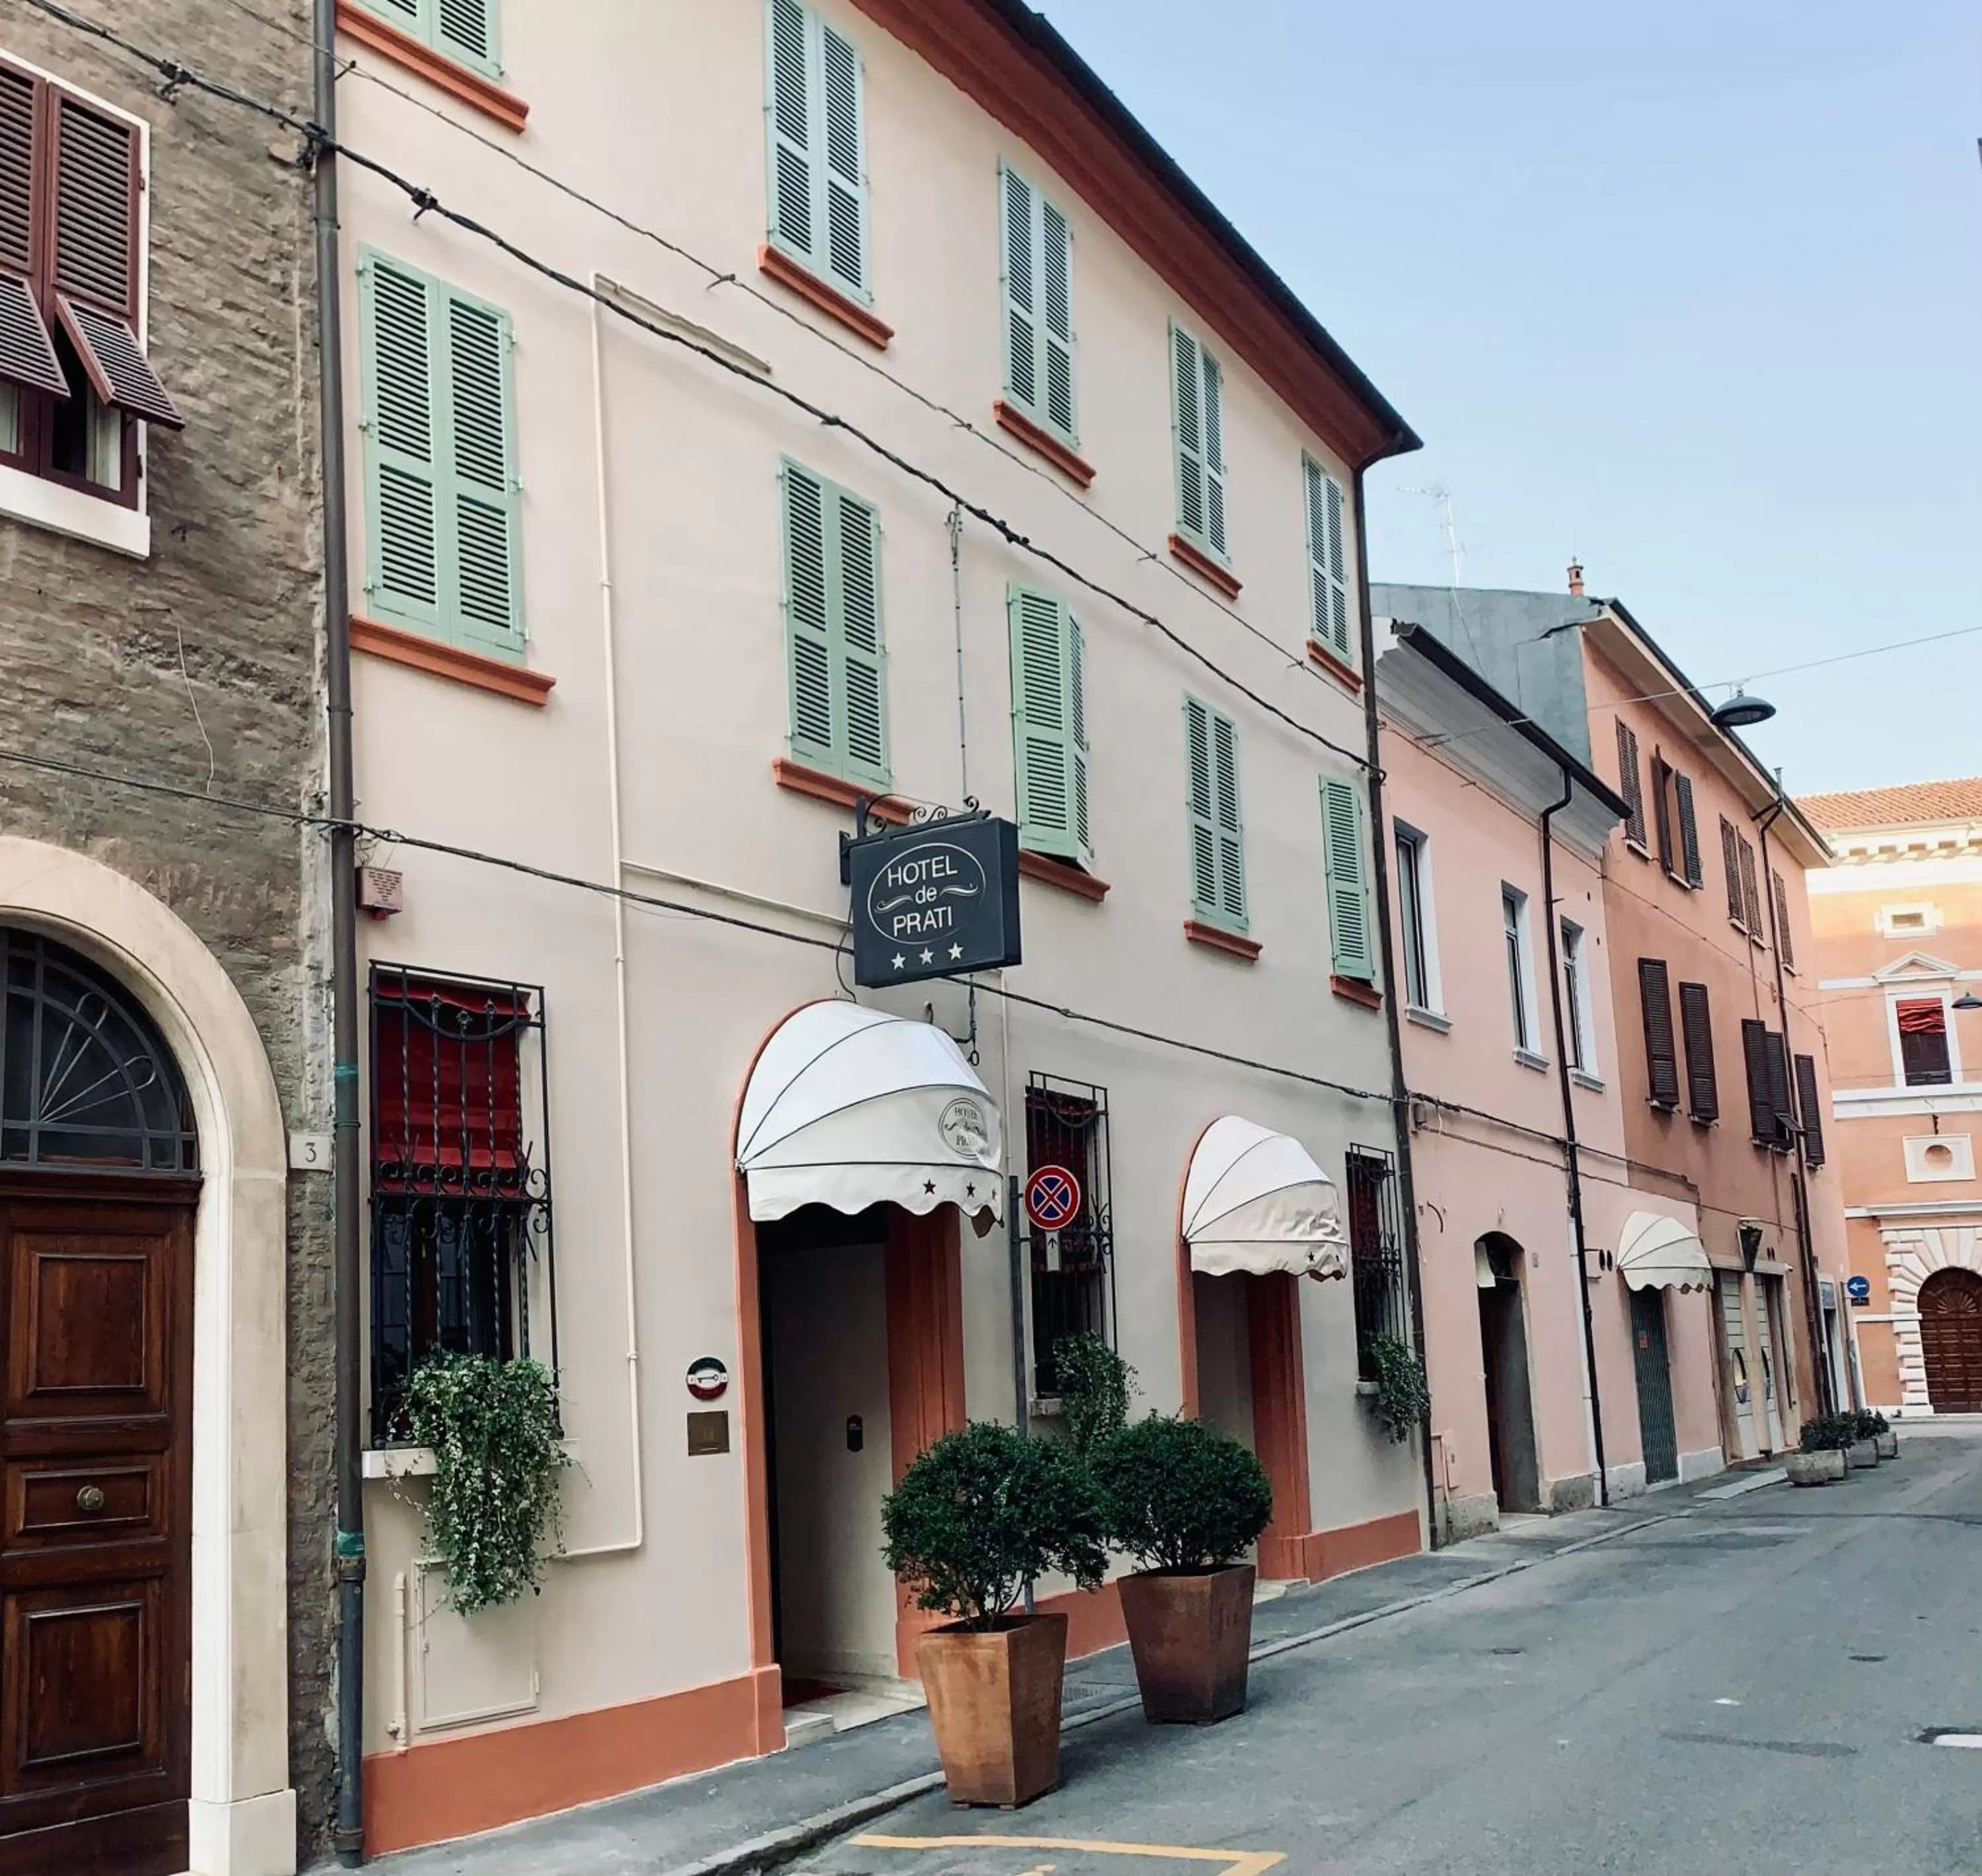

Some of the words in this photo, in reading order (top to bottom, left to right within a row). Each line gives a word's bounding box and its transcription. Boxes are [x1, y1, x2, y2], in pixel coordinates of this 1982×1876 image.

[887, 855, 957, 888] HOTEL
[915, 886, 937, 904] de
[893, 906, 952, 937] PRATI
[306, 1142, 316, 1163] 3
